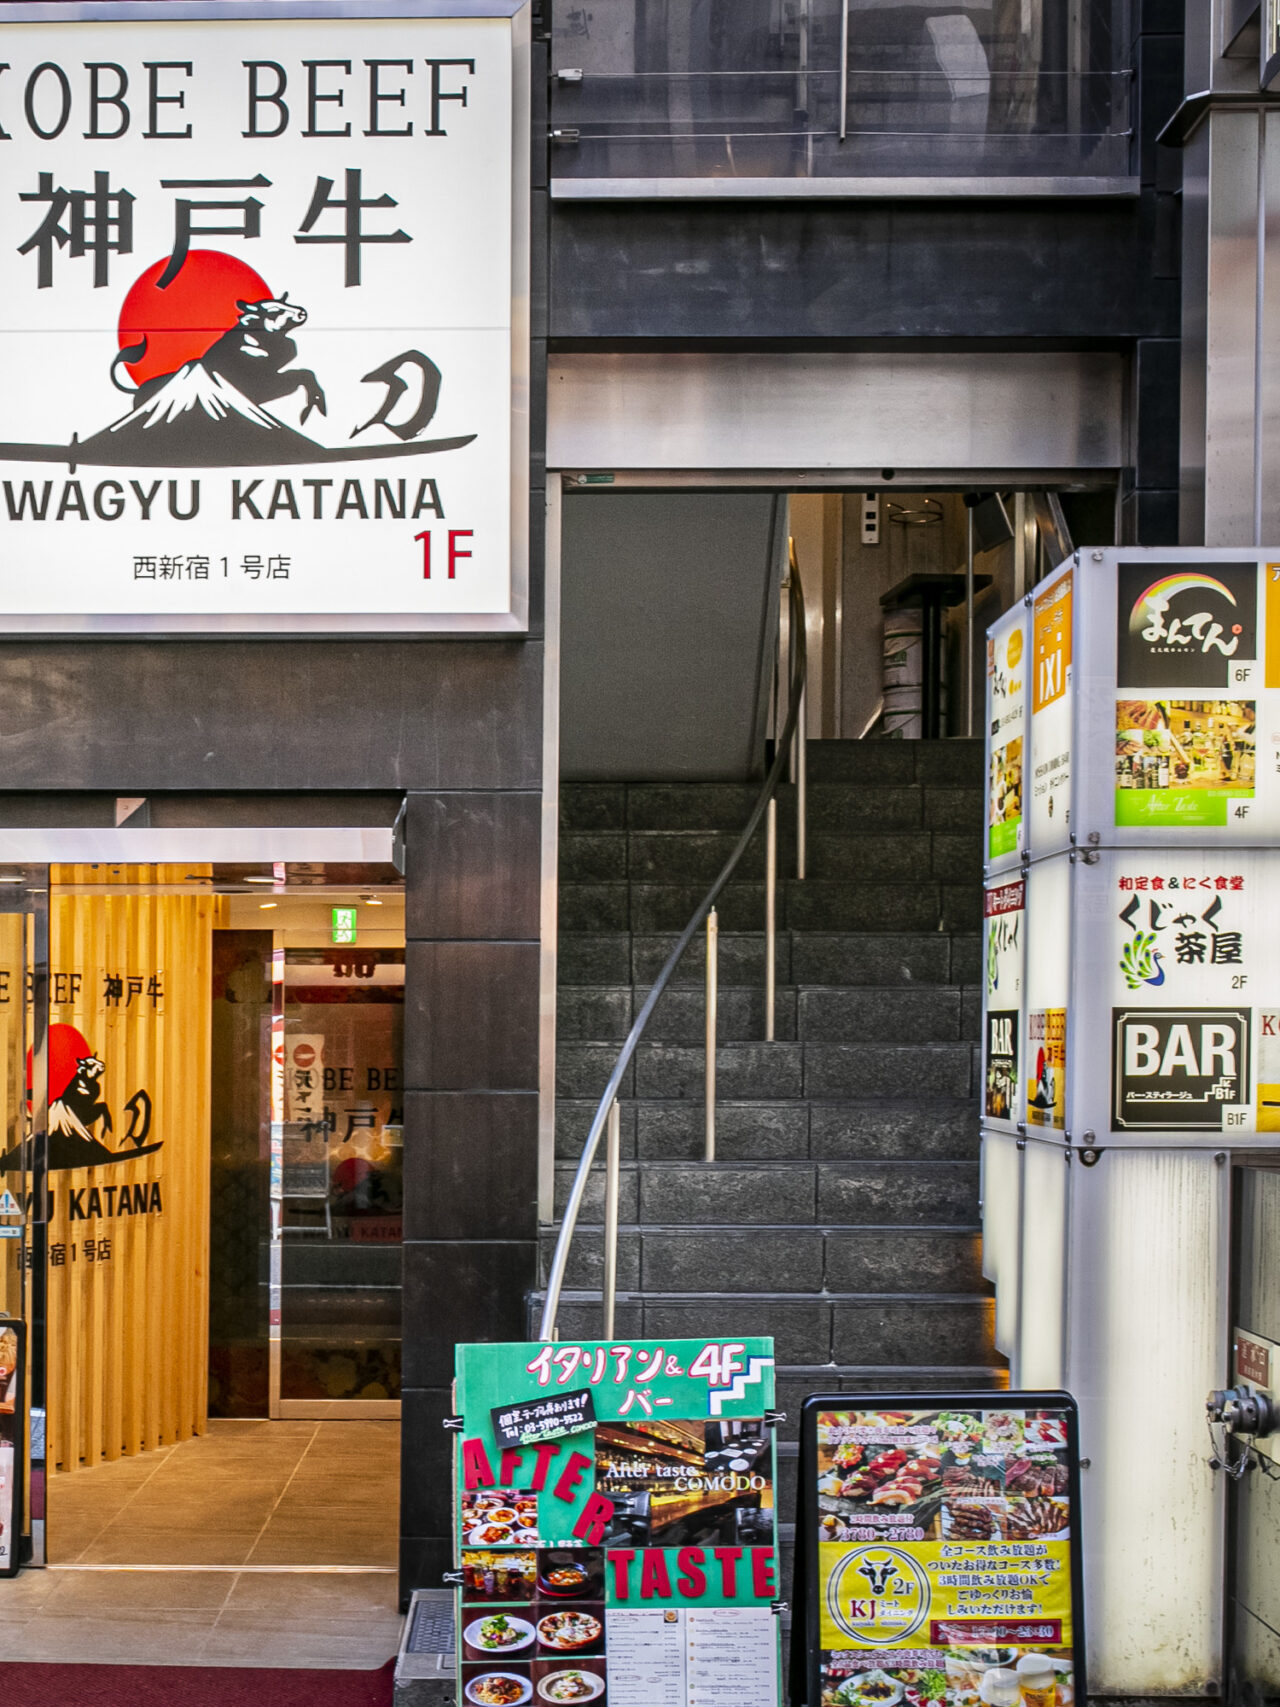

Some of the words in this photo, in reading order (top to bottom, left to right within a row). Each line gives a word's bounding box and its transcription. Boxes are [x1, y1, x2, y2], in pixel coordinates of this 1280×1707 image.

[241, 58, 475, 138] BEEF
[16, 168, 414, 290] 神戸牛
[2, 479, 200, 521] WAGYU
[231, 478, 446, 520] KATANA
[133, 554, 291, 580] 西新宿1号店
[414, 529, 474, 579] 1F
[1142, 596, 1239, 656] まんてん
[1235, 668, 1251, 682] 6F
[1234, 805, 1250, 819] 4F
[1118, 875, 1245, 892] 和定食&にく食堂
[1118, 893, 1223, 931] くじゃく
[1174, 932, 1244, 965] 茶屋
[25, 973, 82, 1004] BEF
[102, 973, 165, 1008] 神戸牛
[1232, 975, 1249, 990] 2F
[991, 1018, 1013, 1056] BAR
[1261, 1014, 1280, 1036] K
[1125, 1023, 1237, 1077] BAR
[1214, 1086, 1237, 1101] B1F
[1227, 1112, 1249, 1126] B1F
[69, 1182, 163, 1222] KATANA
[16, 1236, 113, 1271] 西宿1号店
[687, 1343, 746, 1387] 4F
[618, 1388, 674, 1416] バー
[606, 1461, 649, 1480] After
[656, 1463, 698, 1478] taste
[674, 1475, 767, 1493] COMODO
[462, 1437, 615, 1547] AFTER
[840, 1527, 876, 1542] 3780
[888, 1526, 925, 1542] 2780
[940, 1545, 1048, 1558] 全コース飲み放題が
[607, 1547, 777, 1600] TASTE
[893, 1579, 916, 1596] 2F
[850, 1599, 877, 1620] KJ
[947, 1604, 1043, 1616] しみいただけます!
